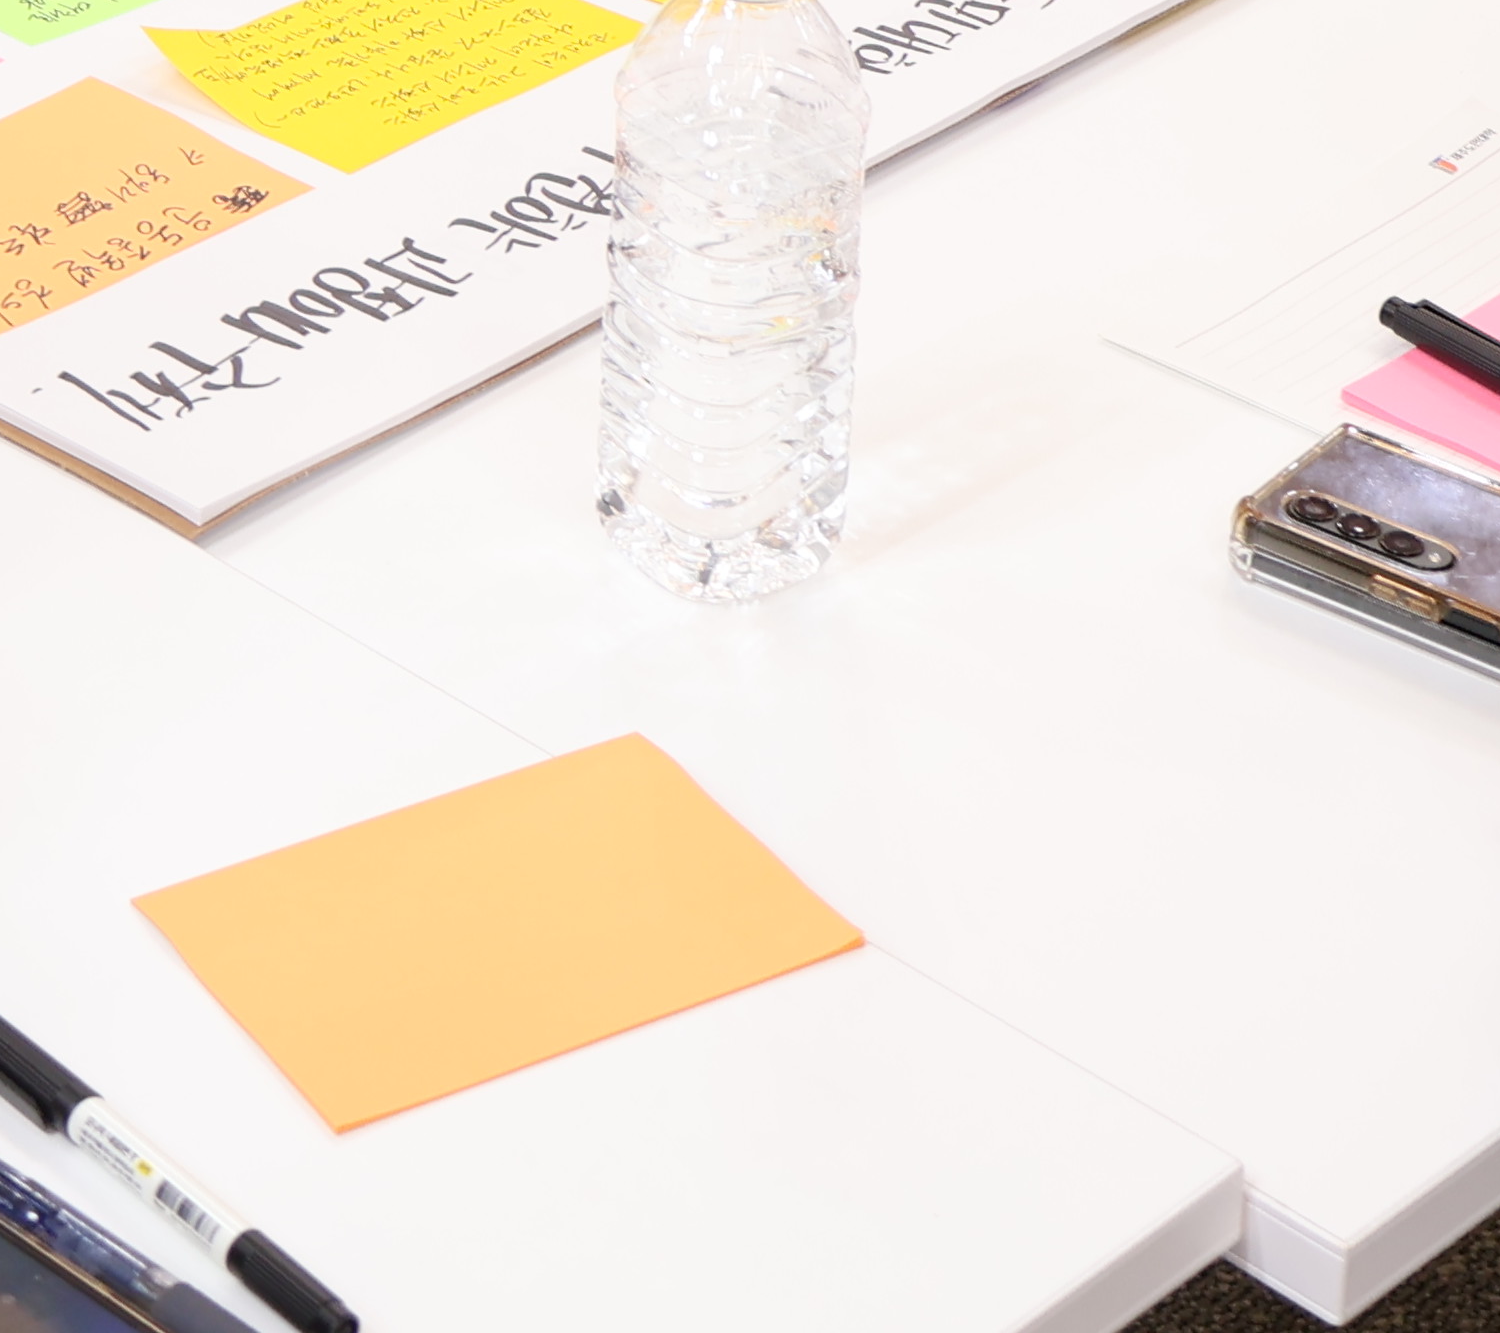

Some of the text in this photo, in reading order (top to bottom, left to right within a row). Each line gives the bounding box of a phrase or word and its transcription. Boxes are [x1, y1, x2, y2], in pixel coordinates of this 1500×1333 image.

[402, 19, 445, 41] 신화
[490, 33, 555, 58] 아는데
[53, 207, 212, 288] 운동종목별
